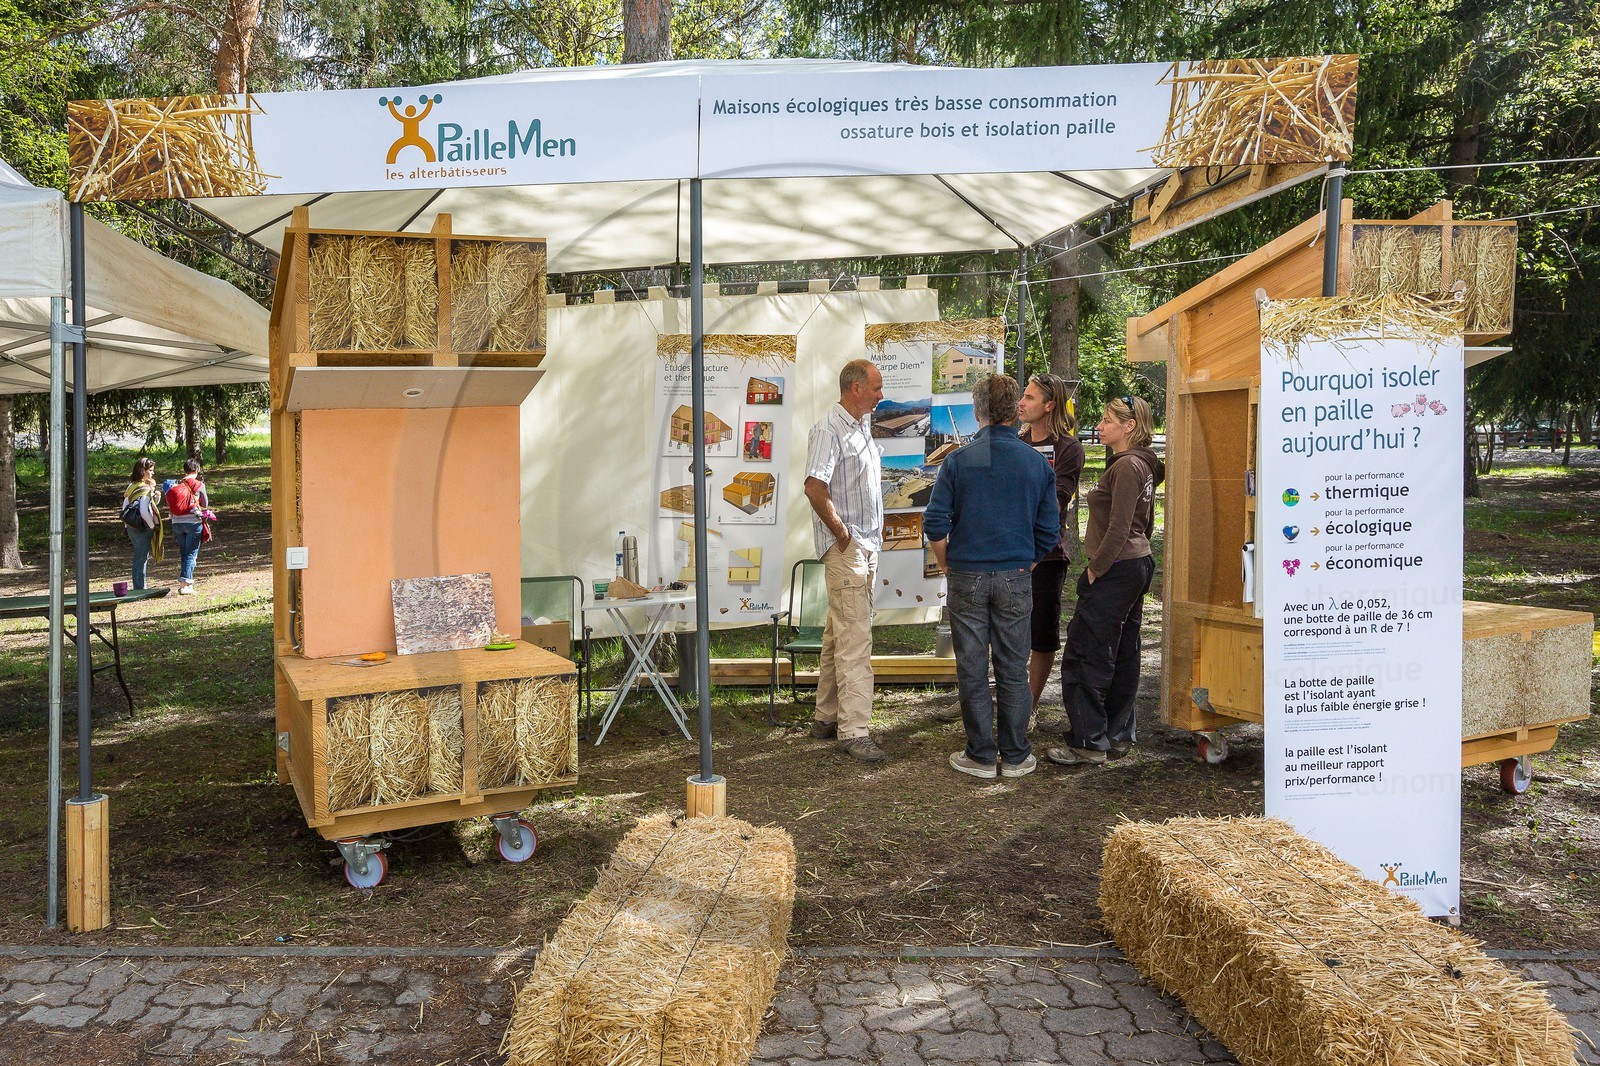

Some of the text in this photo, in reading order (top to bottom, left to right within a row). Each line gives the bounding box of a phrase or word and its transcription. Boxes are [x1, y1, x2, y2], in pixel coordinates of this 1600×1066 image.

[713, 91, 1118, 118] Maisons écologiques très basse consommation
[840, 118, 1116, 140] ossature bois et isolation paille
[437, 118, 576, 163] PailleMen
[386, 166, 507, 180] les alterbâtisseurs
[870, 353, 897, 361] Maison
[664, 362, 691, 373] Études
[663, 374, 673, 382] et
[1282, 365, 1440, 395] Pourquoi isoler
[1281, 398, 1374, 427] en paille
[1282, 426, 1421, 458] aujourd’hui ?
[1324, 471, 1405, 482] pour la performance
[1325, 484, 1410, 500] thermique
[1325, 506, 1405, 517] pour la performance
[1325, 519, 1412, 536] écologique
[1325, 541, 1405, 553] pour la performance
[1325, 554, 1423, 570] économique
[1283, 602, 1308, 612] Avec
[1311, 602, 1325, 611] un
[1340, 600, 1354, 610] de
[1356, 598, 1391, 611] 0,052,
[1284, 610, 1433, 625] une botte de paille de 36 cm
[1283, 625, 1342, 638] correspond
[1345, 625, 1351, 635] à
[1354, 625, 1368, 634] un
[1371, 623, 1378, 633] R
[1380, 623, 1393, 633] de
[1396, 622, 1404, 632] 7
[1284, 675, 1375, 689] La botte de paille
[1284, 688, 1376, 702] est l’isolant ayant
[1284, 698, 1426, 715] la plus faible énergie grise !
[1285, 743, 1388, 759] la paille est l’isolant
[1285, 758, 1385, 772] au meilleur rapport
[1285, 772, 1382, 789] prix/performance !
[1400, 870, 1448, 887] PailleMen
